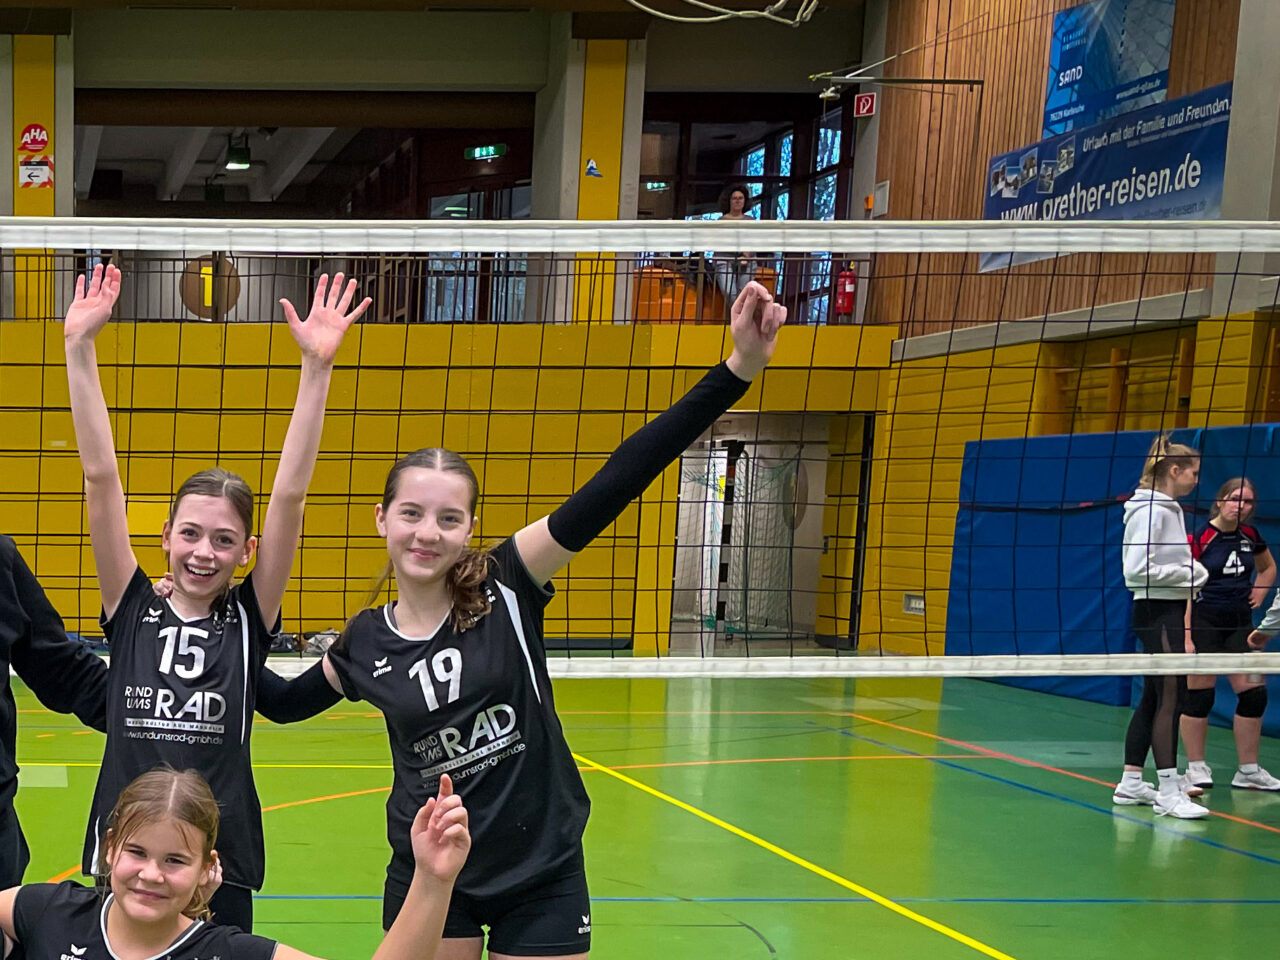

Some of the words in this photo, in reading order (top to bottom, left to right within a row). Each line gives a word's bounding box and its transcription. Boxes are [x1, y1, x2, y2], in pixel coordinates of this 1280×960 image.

[21, 128, 48, 144] AHA
[1083, 132, 1108, 152] Urlaub
[1136, 114, 1165, 136] Familie
[1167, 108, 1183, 127] und
[200, 266, 213, 307] 1
[1223, 551, 1246, 577] 4
[158, 626, 209, 679] 15
[372, 665, 392, 678] erima
[408, 647, 463, 712] 19
[126, 698, 152, 710] UMS
[154, 688, 227, 721] RAD
[413, 735, 438, 754] RUND
[439, 703, 517, 759] RAD
